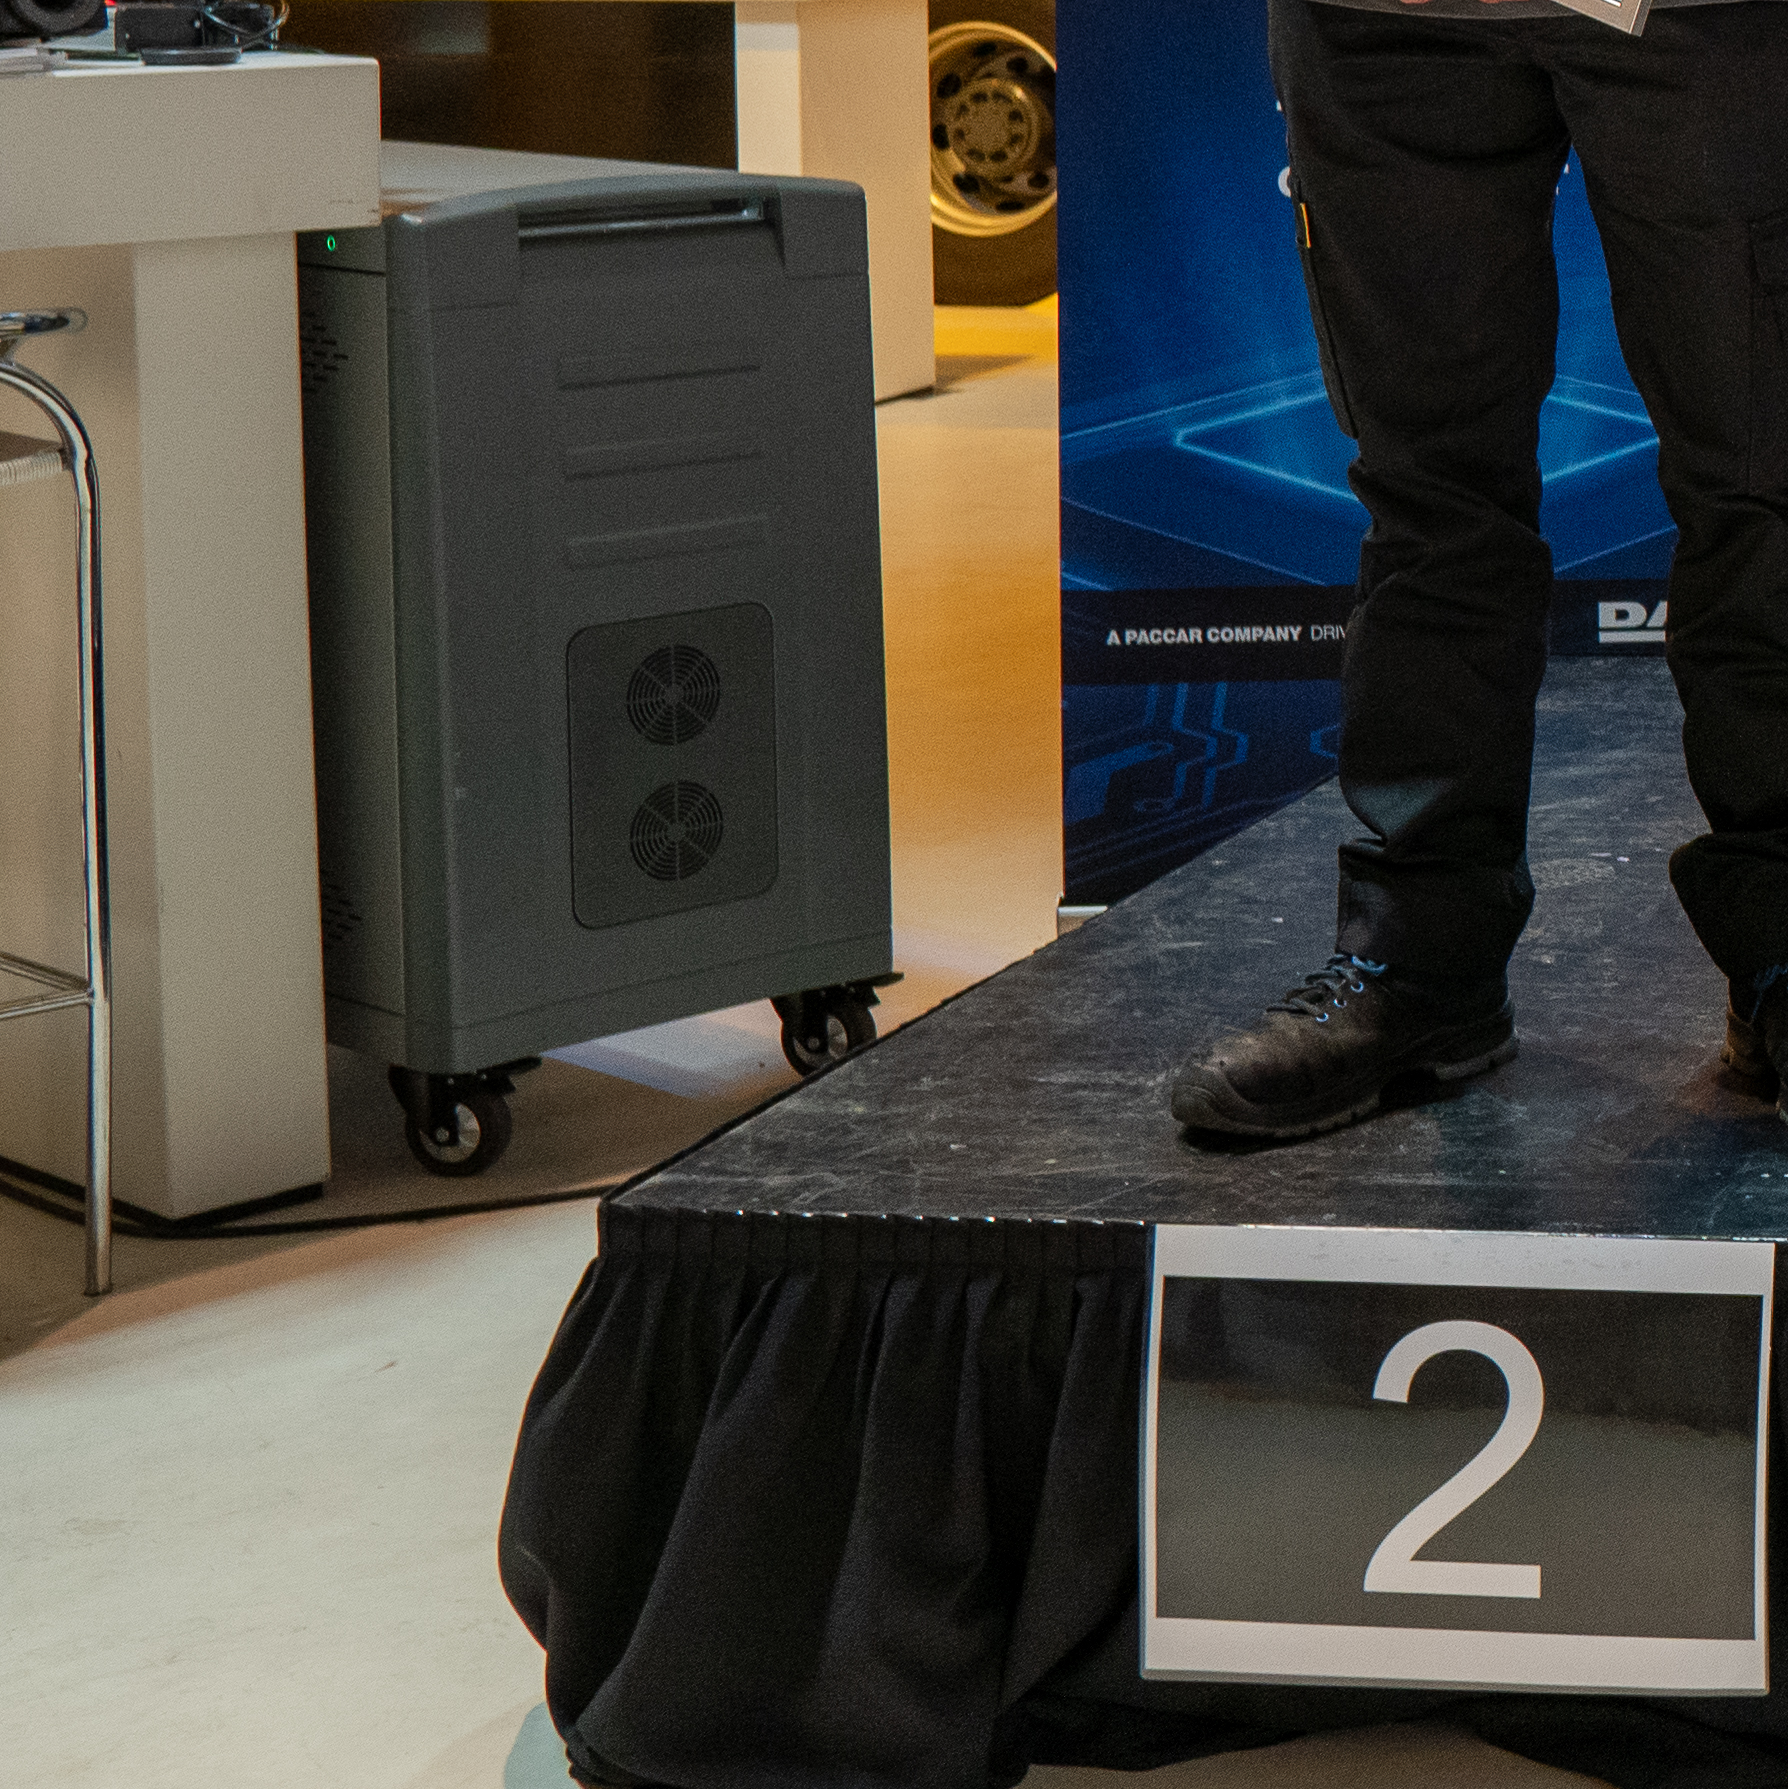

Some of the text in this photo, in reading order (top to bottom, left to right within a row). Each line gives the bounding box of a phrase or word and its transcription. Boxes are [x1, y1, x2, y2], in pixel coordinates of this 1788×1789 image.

[1107, 626, 1302, 646] A PACCAR COMPANY
[1364, 1320, 1544, 1598] 2
